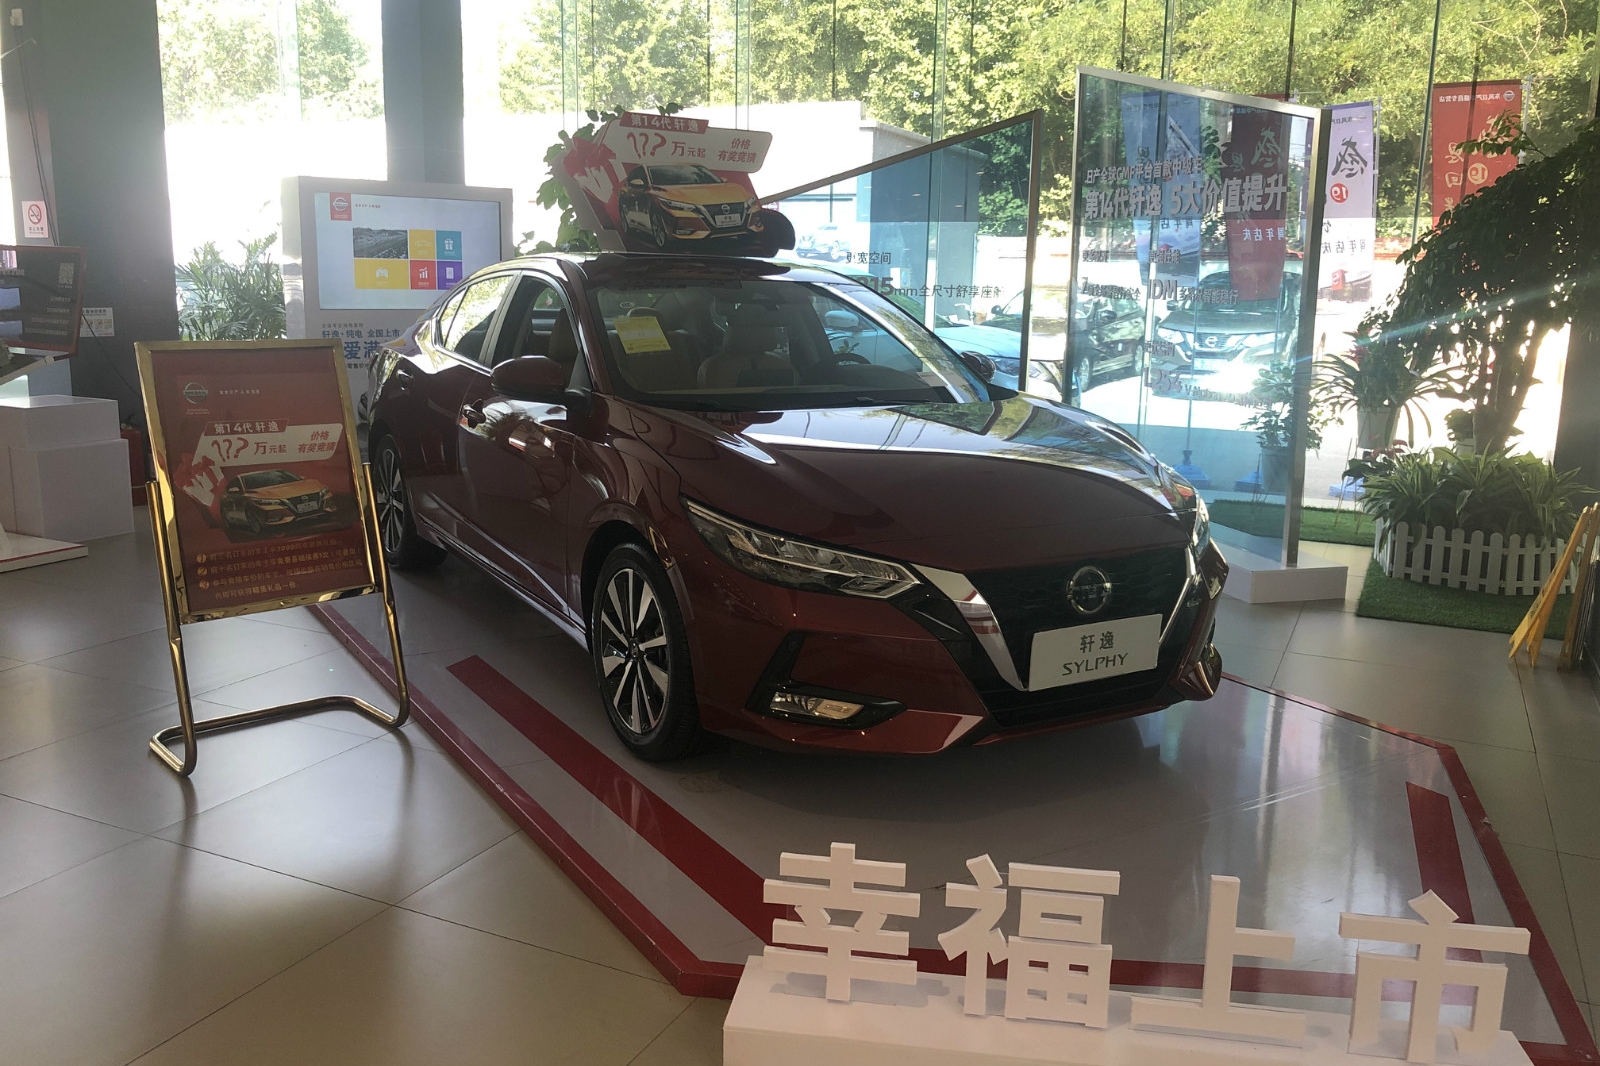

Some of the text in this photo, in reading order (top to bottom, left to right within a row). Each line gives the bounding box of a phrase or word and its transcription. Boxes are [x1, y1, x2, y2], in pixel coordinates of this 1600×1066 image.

[671, 140, 706, 159] 万元起
[731, 137, 751, 149] 价格
[717, 150, 757, 163] 有奖竞猜
[1084, 172, 1289, 220] 第14代轩逸 5大价值提升
[846, 252, 892, 265] 更宽空间
[366, 328, 400, 338] 全国上市
[214, 421, 279, 435] 第14代轩逸
[310, 430, 330, 441] 价格
[253, 441, 287, 455] 万元起
[297, 441, 337, 454] 有奖竞猜
[1080, 630, 1115, 654] 轩逸
[1061, 652, 1129, 677] SYLPHY
[763, 842, 1531, 1064] 幸福上市
